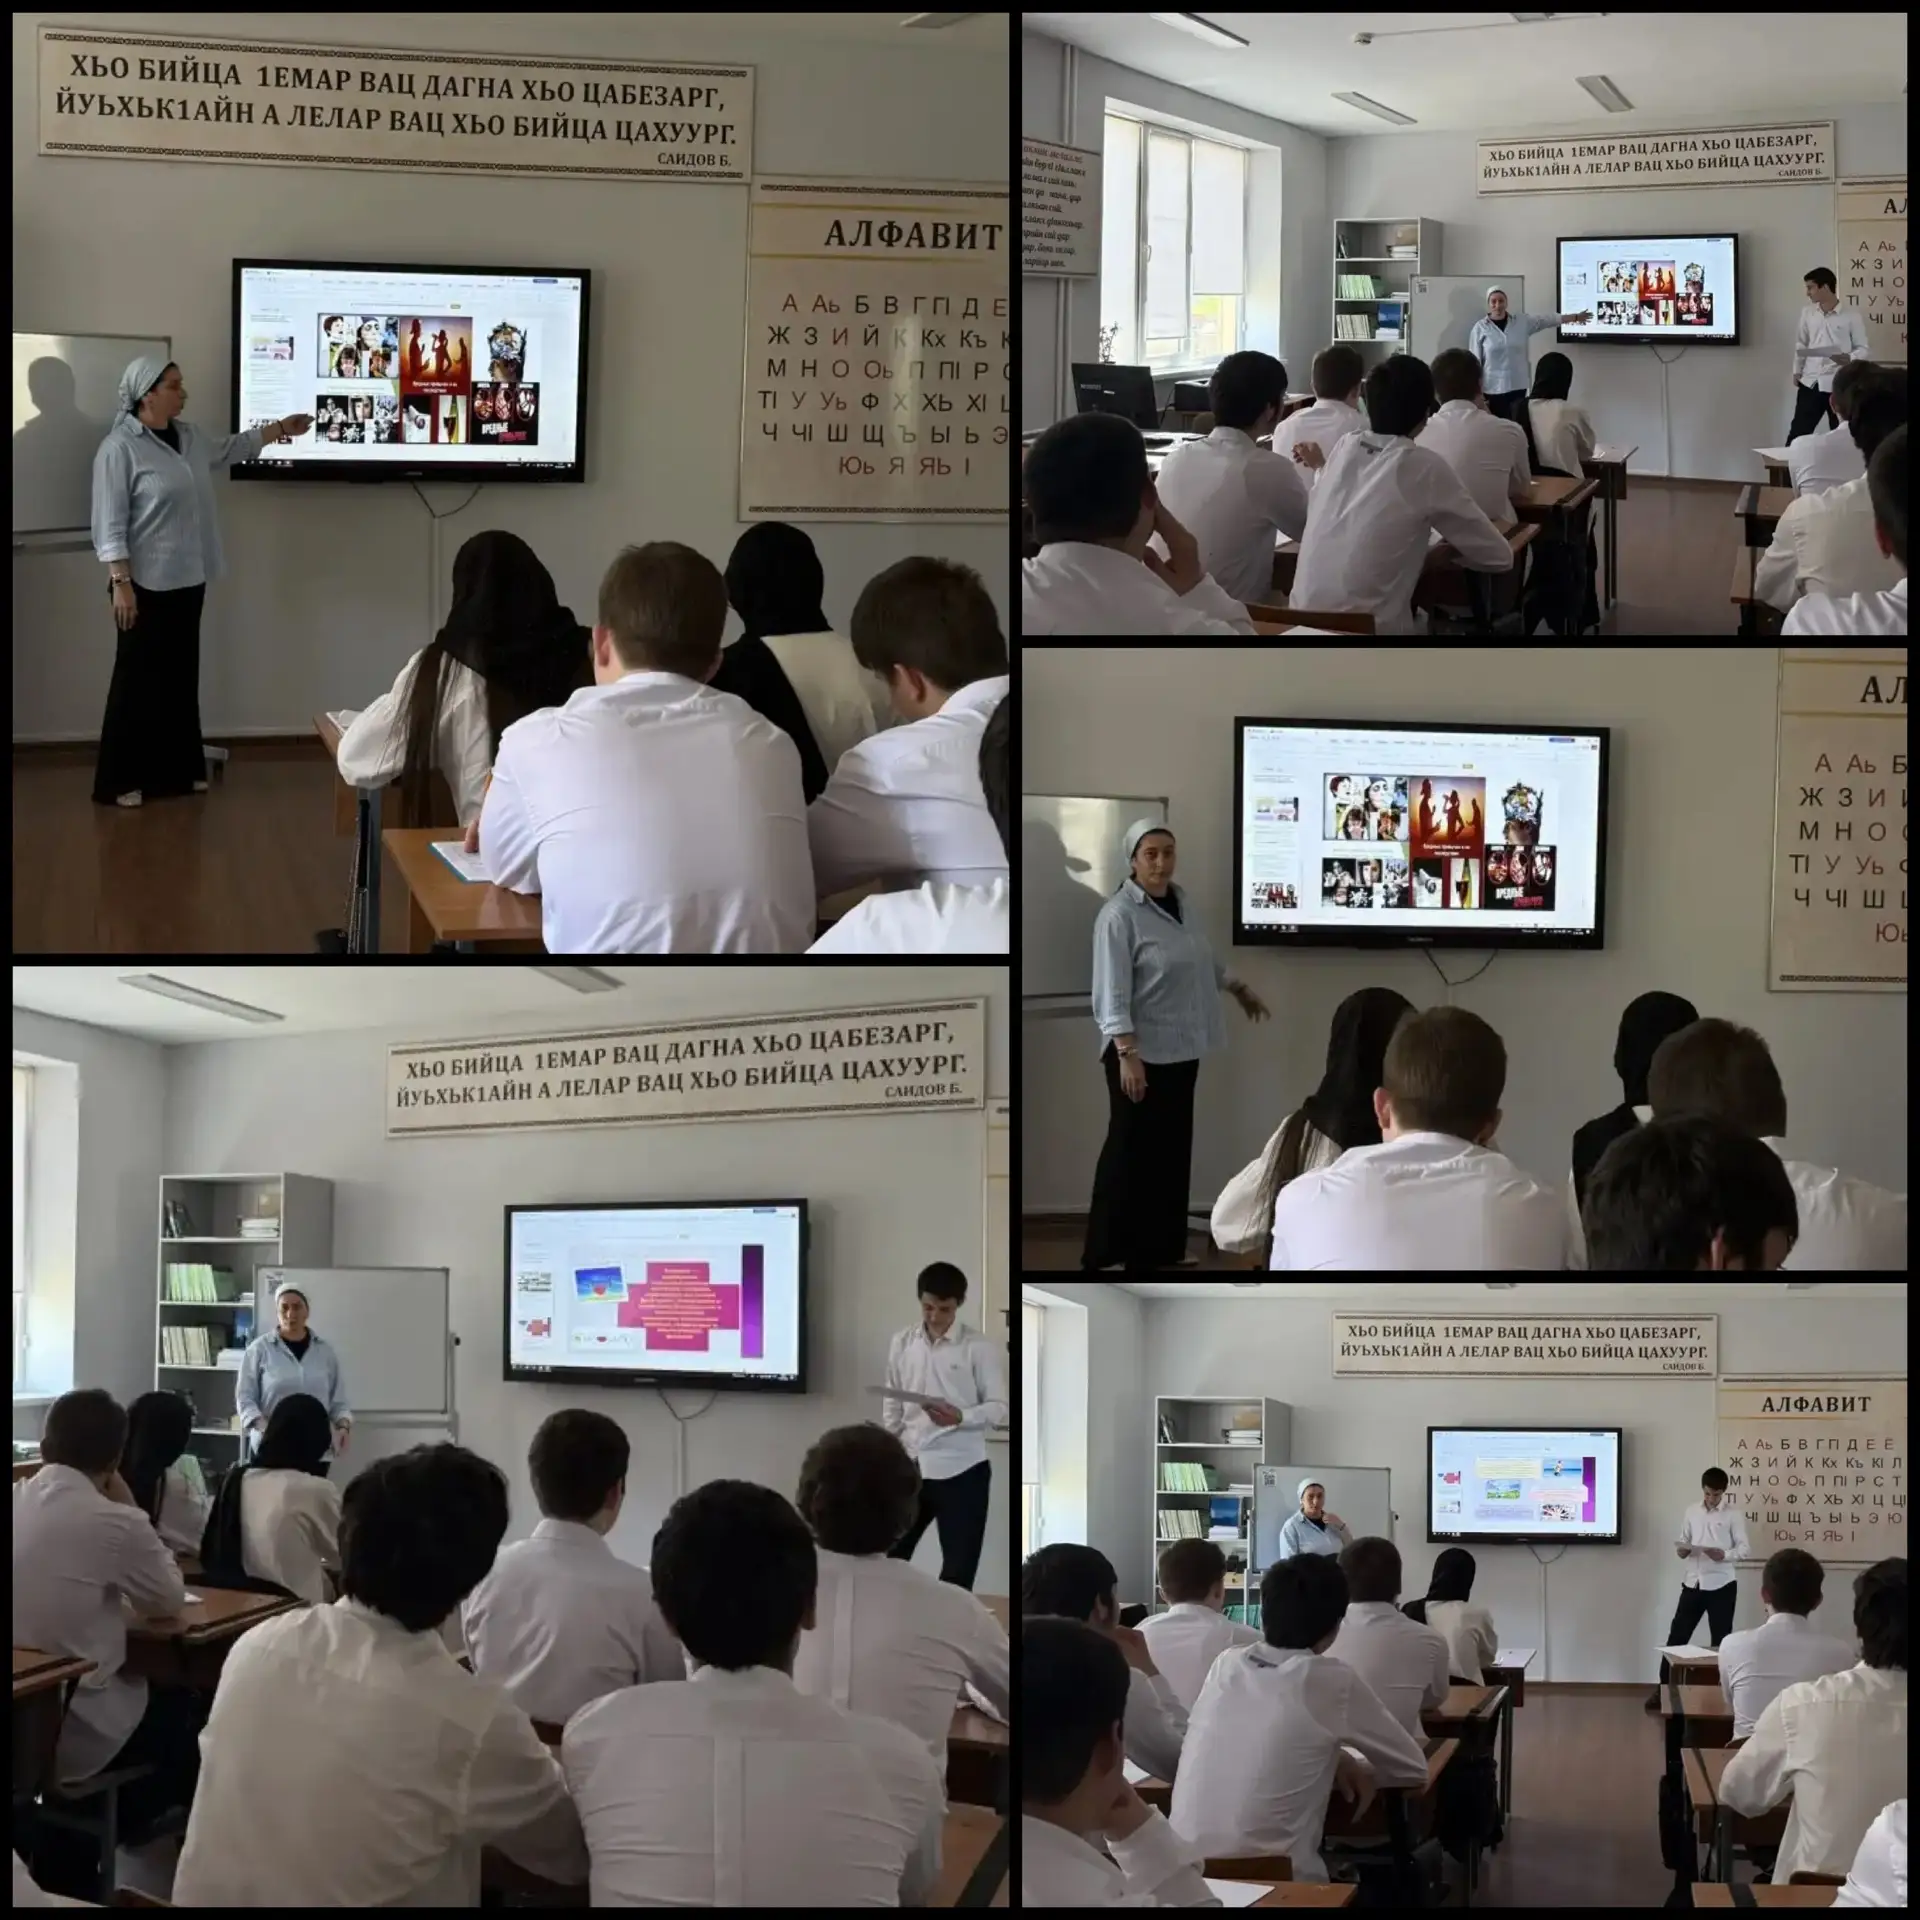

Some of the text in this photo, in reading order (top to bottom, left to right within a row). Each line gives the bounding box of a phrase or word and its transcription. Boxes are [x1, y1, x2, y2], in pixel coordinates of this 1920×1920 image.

[70, 54, 128, 78] ХЬО
[139, 57, 241, 88] БИЙЦА
[360, 72, 415, 98] ВАЦ
[422, 75, 514, 100] ДАГНА
[522, 80, 574, 102] ХЬО
[262, 104, 280, 125] А
[288, 105, 381, 129] ЛЕЛАР
[390, 110, 444, 137] ВАЦ
[452, 114, 504, 135] ХЬО
[514, 112, 607, 144] БИЙЦА
[658, 153, 731, 167] САИДОВ Б.
[1490, 150, 1514, 161] ХЬО
[1518, 146, 1564, 160] БИЙЦА
[1620, 144, 1647, 155] ВАЦ
[1650, 141, 1698, 155] ДАГНА
[1702, 139, 1730, 151] ХЬО
[1574, 164, 1581, 174] А
[1585, 162, 1630, 174] ЛЕЛАР
[1635, 160, 1662, 172] ВАЦ
[1666, 159, 1694, 170] ХЬО
[1698, 154, 1749, 168] БИЙЦА
[823, 219, 1003, 251] АЛФАВИТ
[407, 1061, 444, 1078] ХЬО
[452, 1052, 524, 1076] БИЙЦА
[614, 1044, 658, 1064] ВАЦ
[665, 1038, 745, 1064] ДАГНА
[753, 1033, 802, 1054] ХЬО
[538, 1082, 550, 1098] А
[556, 1076, 630, 1098] ЛЕЛАР
[637, 1073, 683, 1094] ВАЦ
[691, 1070, 737, 1089] ХЬО
[745, 1060, 833, 1086] БИЙЦА
[1349, 1326, 1378, 1336] ХЬО
[1383, 1323, 1435, 1339] БИЙЦА
[1498, 1327, 1528, 1340] ВАЦ
[1532, 1327, 1581, 1340] ДАГНА
[1586, 1327, 1615, 1338] ХЬО
[1447, 1346, 1456, 1357] А
[1459, 1346, 1510, 1357] ЛЕЛАР
[1514, 1346, 1544, 1359] ВАЦ
[1548, 1346, 1577, 1358] ХЬО
[1582, 1344, 1634, 1360] БИЙЦА
[1761, 1395, 1872, 1413] АЛФАВИТ
